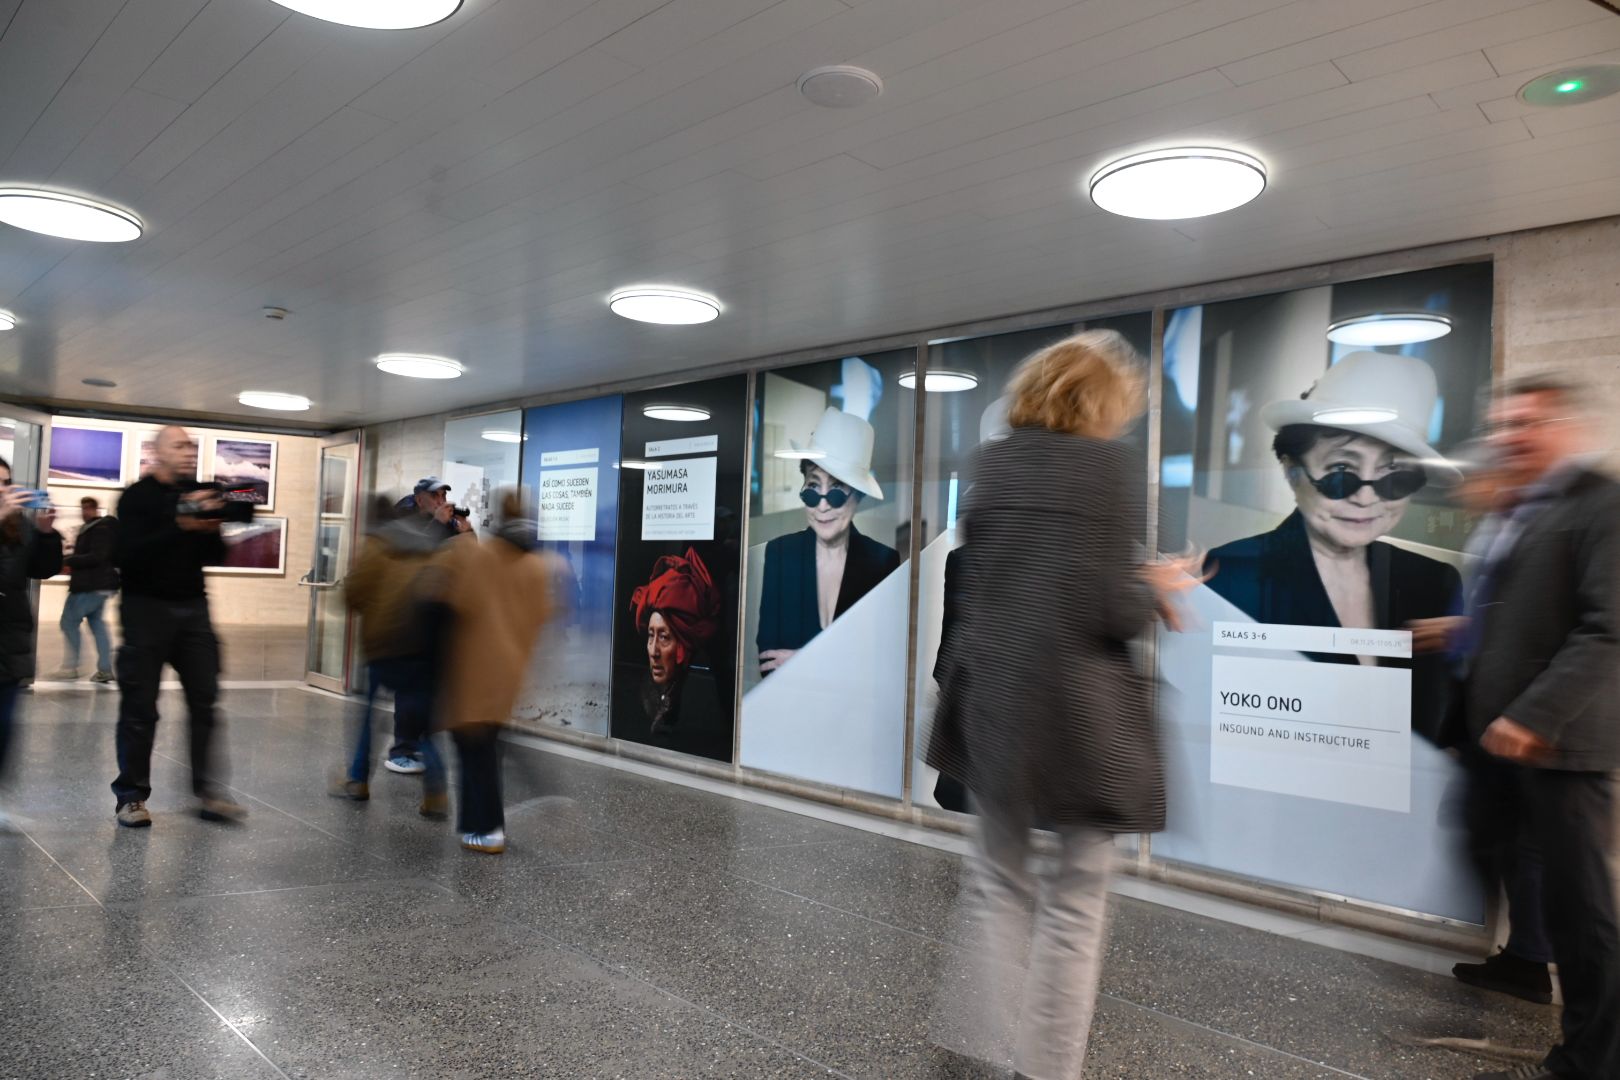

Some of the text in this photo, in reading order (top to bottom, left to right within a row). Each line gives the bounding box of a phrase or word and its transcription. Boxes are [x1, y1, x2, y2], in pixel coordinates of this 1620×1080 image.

[647, 468, 688, 481] YASUMASA
[542, 477, 590, 488] ASÍ COMO SUCEDEN
[646, 482, 688, 495] MORIMURA
[541, 490, 552, 500] LAS
[570, 487, 593, 498] TAMBIÉN
[541, 501, 575, 511] NADA SUCEDE
[1221, 630, 1267, 641] SALAS 3-6
[1220, 690, 1302, 713] YOKO ONO
[1219, 722, 1371, 750] INSOUND AND INSTRUCTURE
